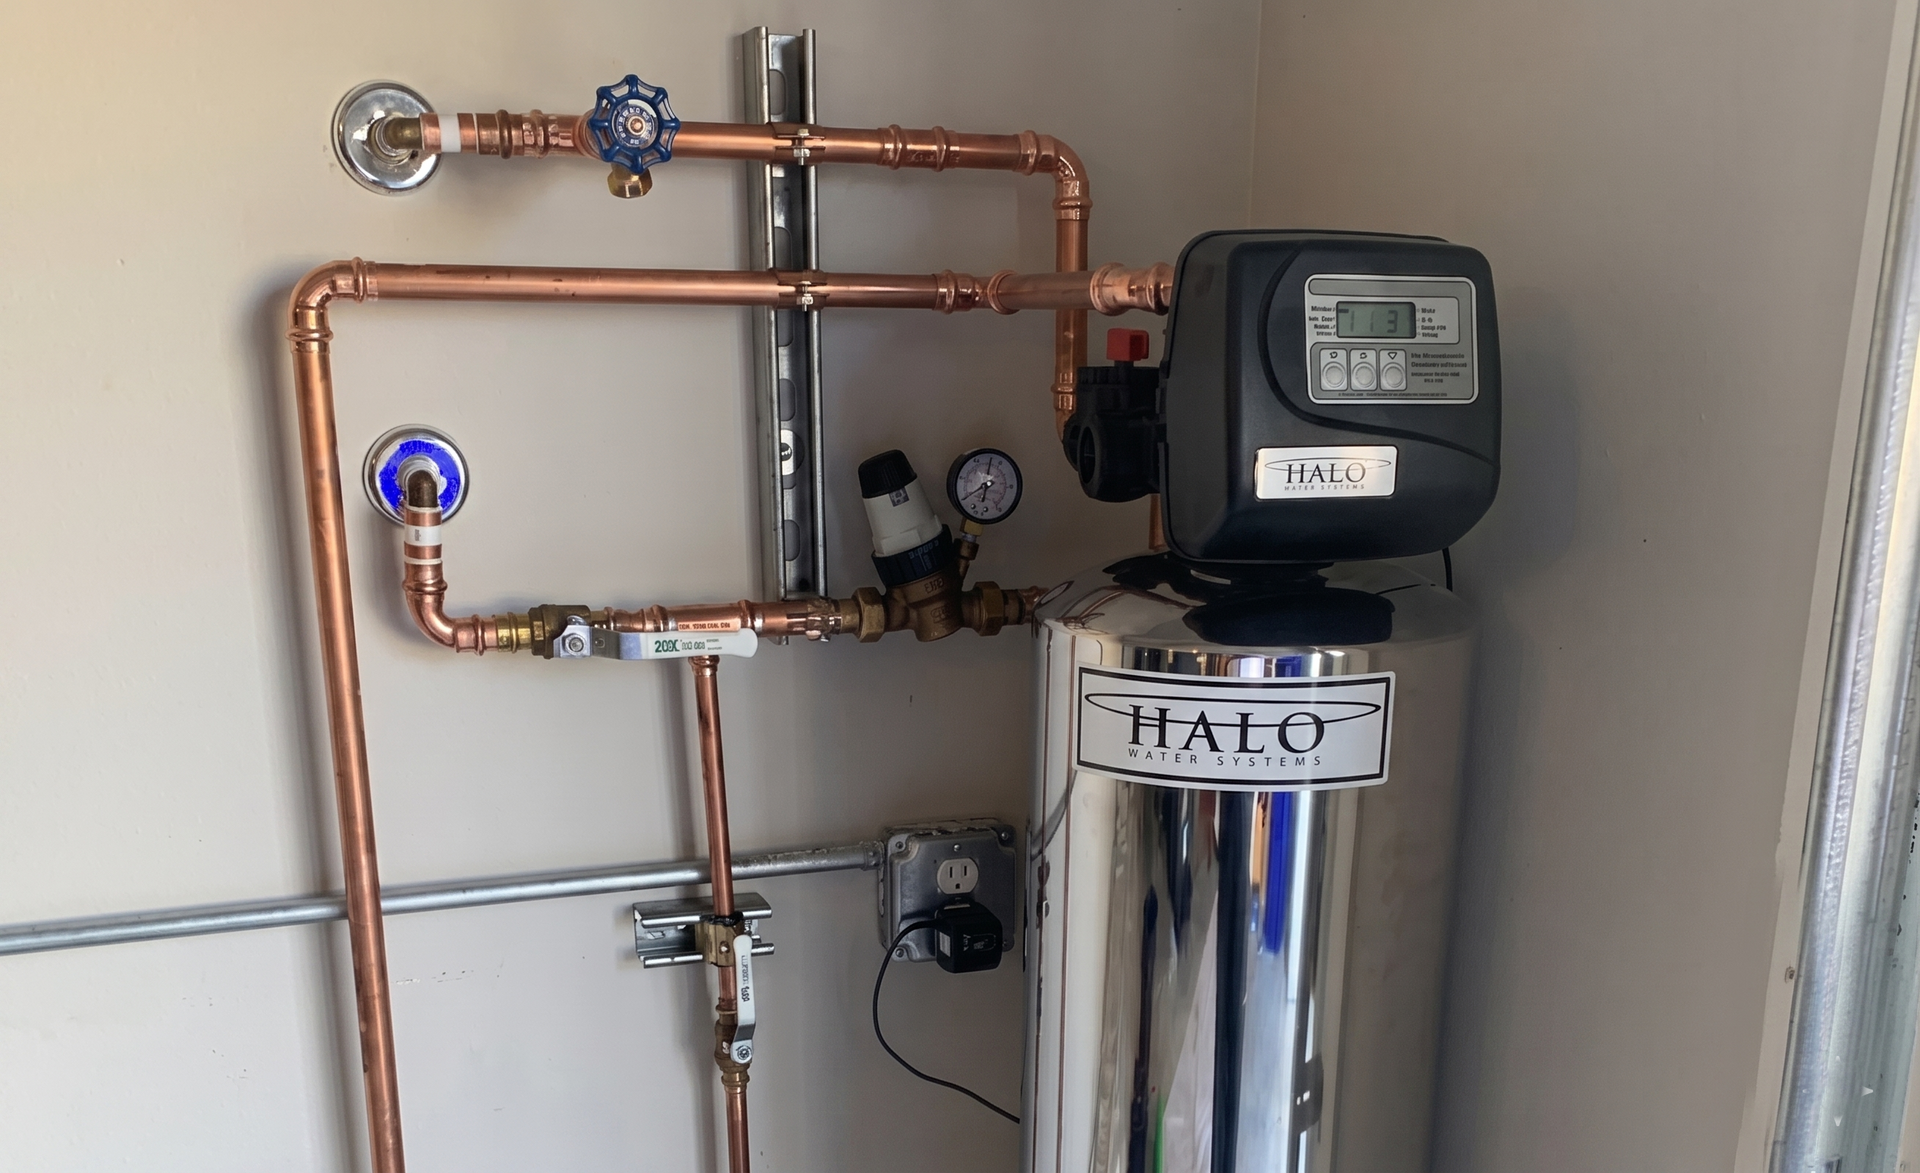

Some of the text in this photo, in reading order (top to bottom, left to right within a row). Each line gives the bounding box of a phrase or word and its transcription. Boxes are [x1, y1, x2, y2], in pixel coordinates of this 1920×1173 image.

[1286, 462, 1366, 484] HALO
[1128, 703, 1325, 754] HALO
[1128, 747, 1322, 767] WATER SYSTEMS
